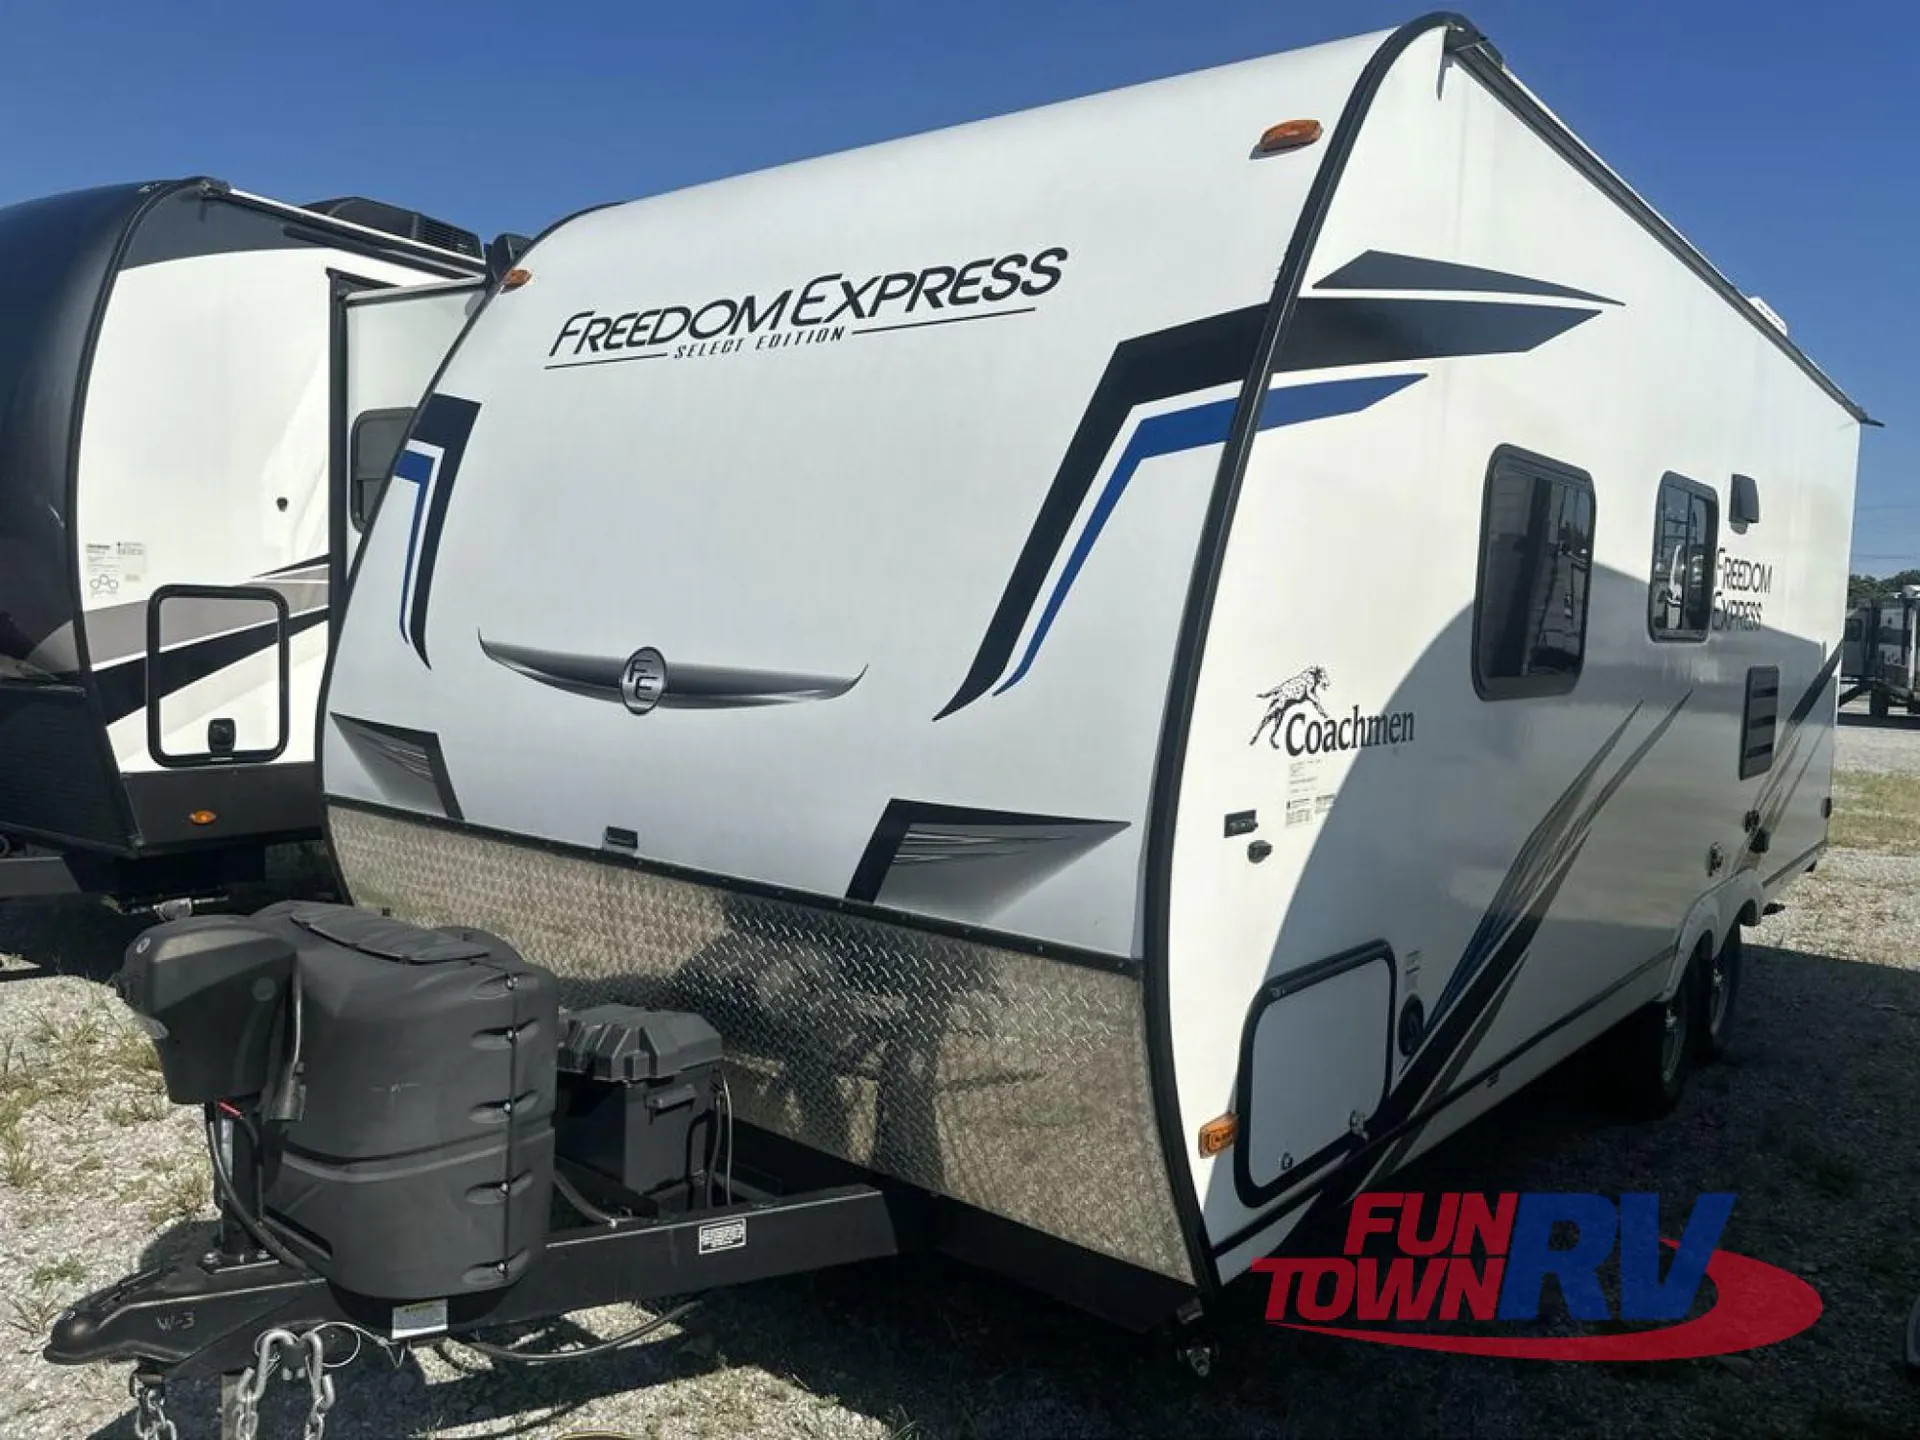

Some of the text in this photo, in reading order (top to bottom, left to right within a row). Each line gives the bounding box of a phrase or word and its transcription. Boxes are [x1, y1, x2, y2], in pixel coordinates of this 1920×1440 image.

[549, 246, 1069, 357] FREEDOM EXPRESS
[673, 326, 845, 359] SELECT EDITION
[1715, 547, 1773, 594] FREEDOM
[1711, 591, 1762, 632] EXPRESS
[1285, 704, 1416, 757] Coachmen
